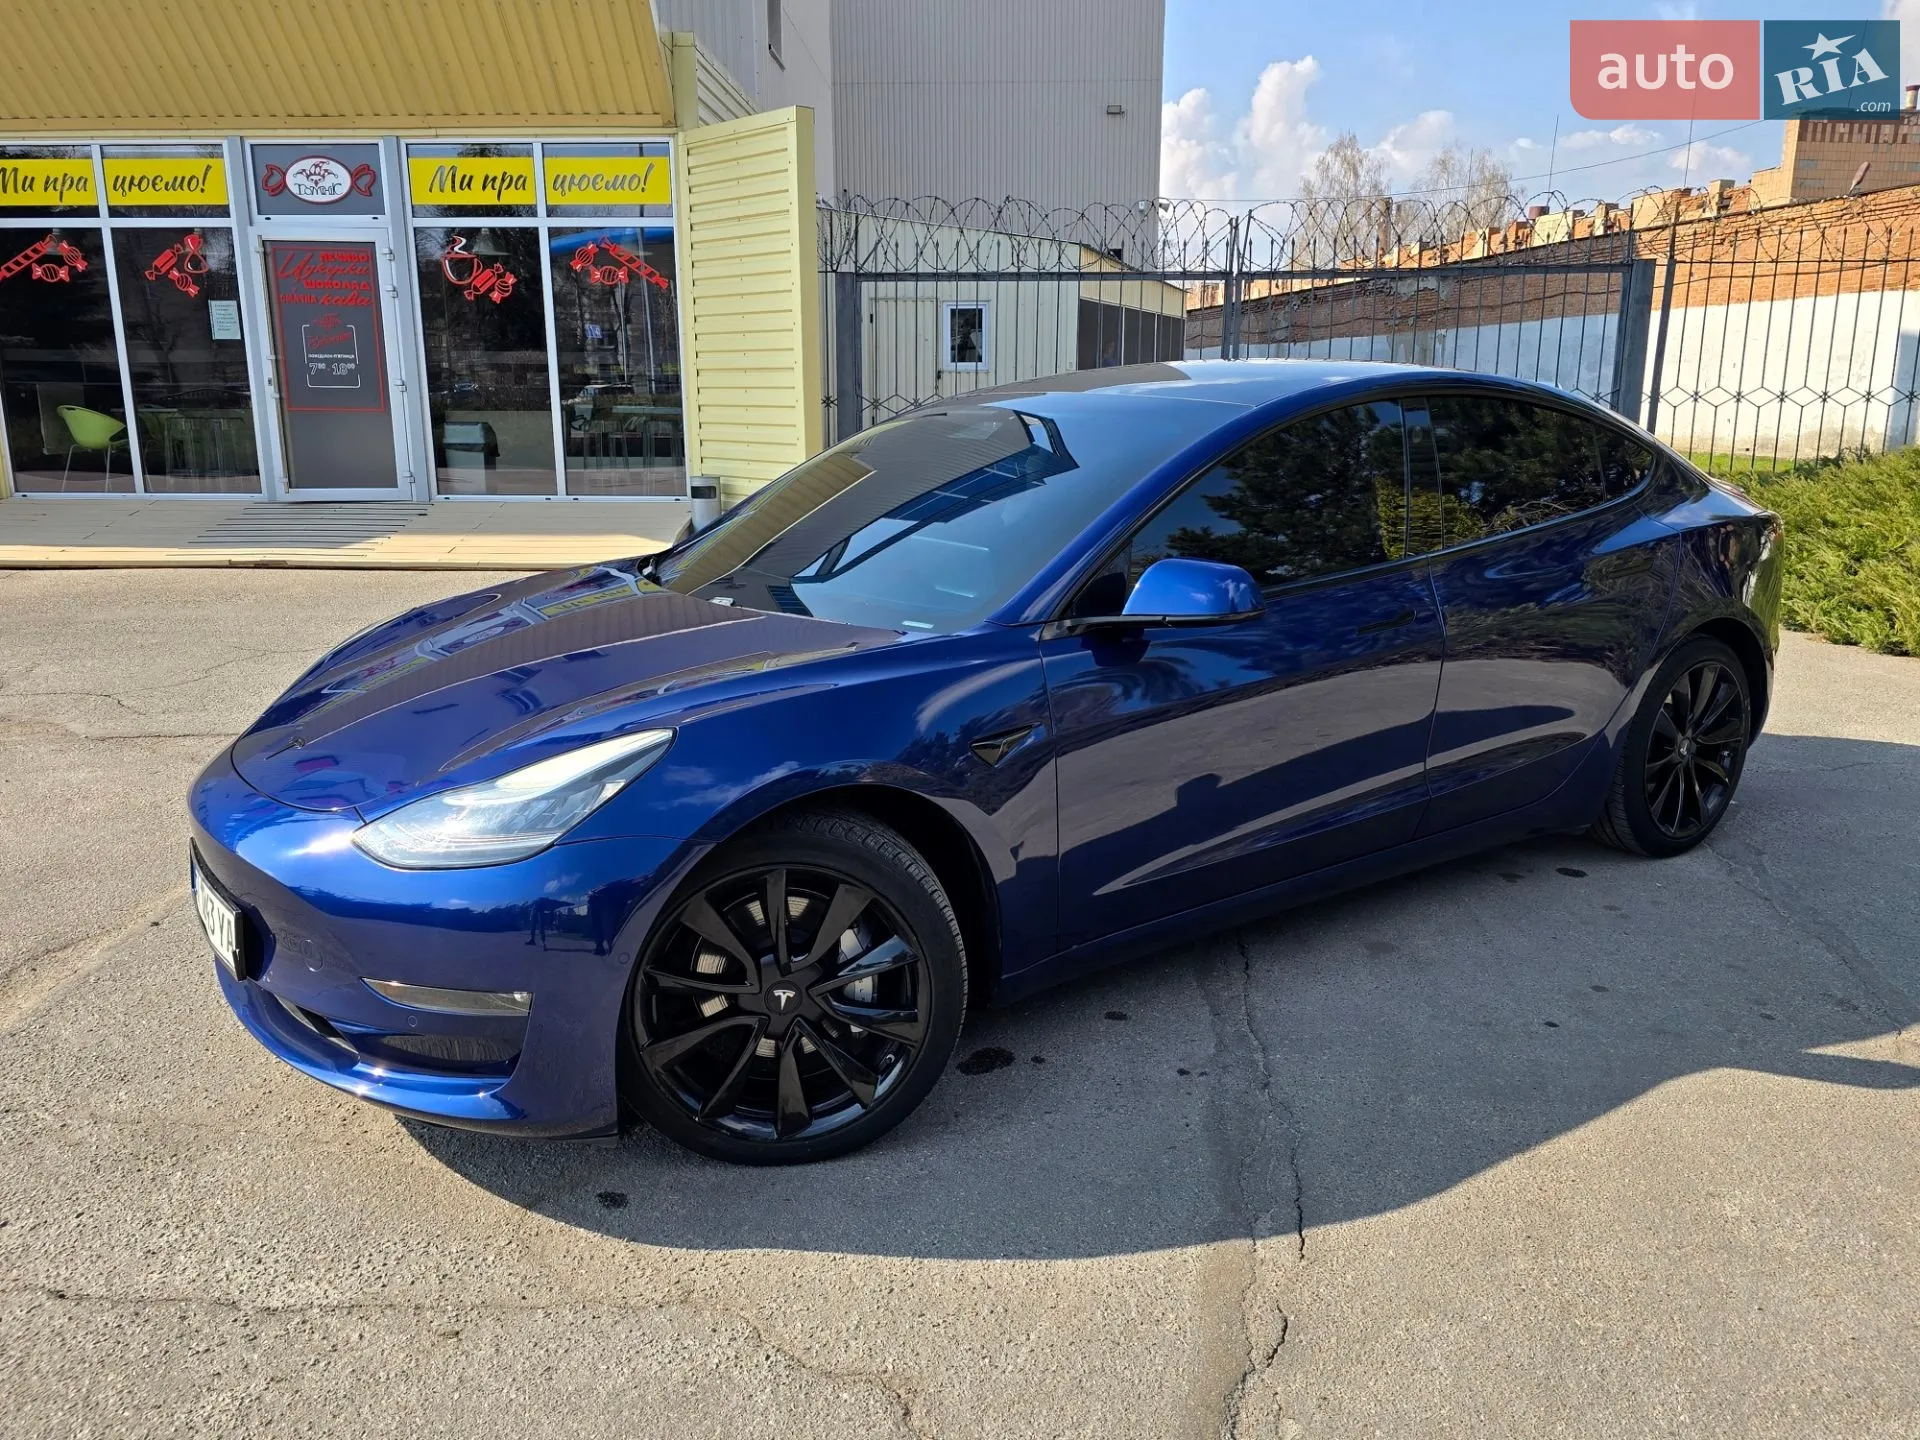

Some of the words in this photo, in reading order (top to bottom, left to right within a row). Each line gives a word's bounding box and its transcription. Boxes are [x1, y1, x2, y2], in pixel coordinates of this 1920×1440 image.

[0, 166, 36, 194] Ми
[43, 172, 88, 204] пра
[112, 164, 212, 197] цюємо!
[428, 164, 474, 193] Ми
[482, 170, 528, 202] пра
[552, 162, 655, 197] цюємо!
[303, 279, 370, 291] ШОКОЛАД
